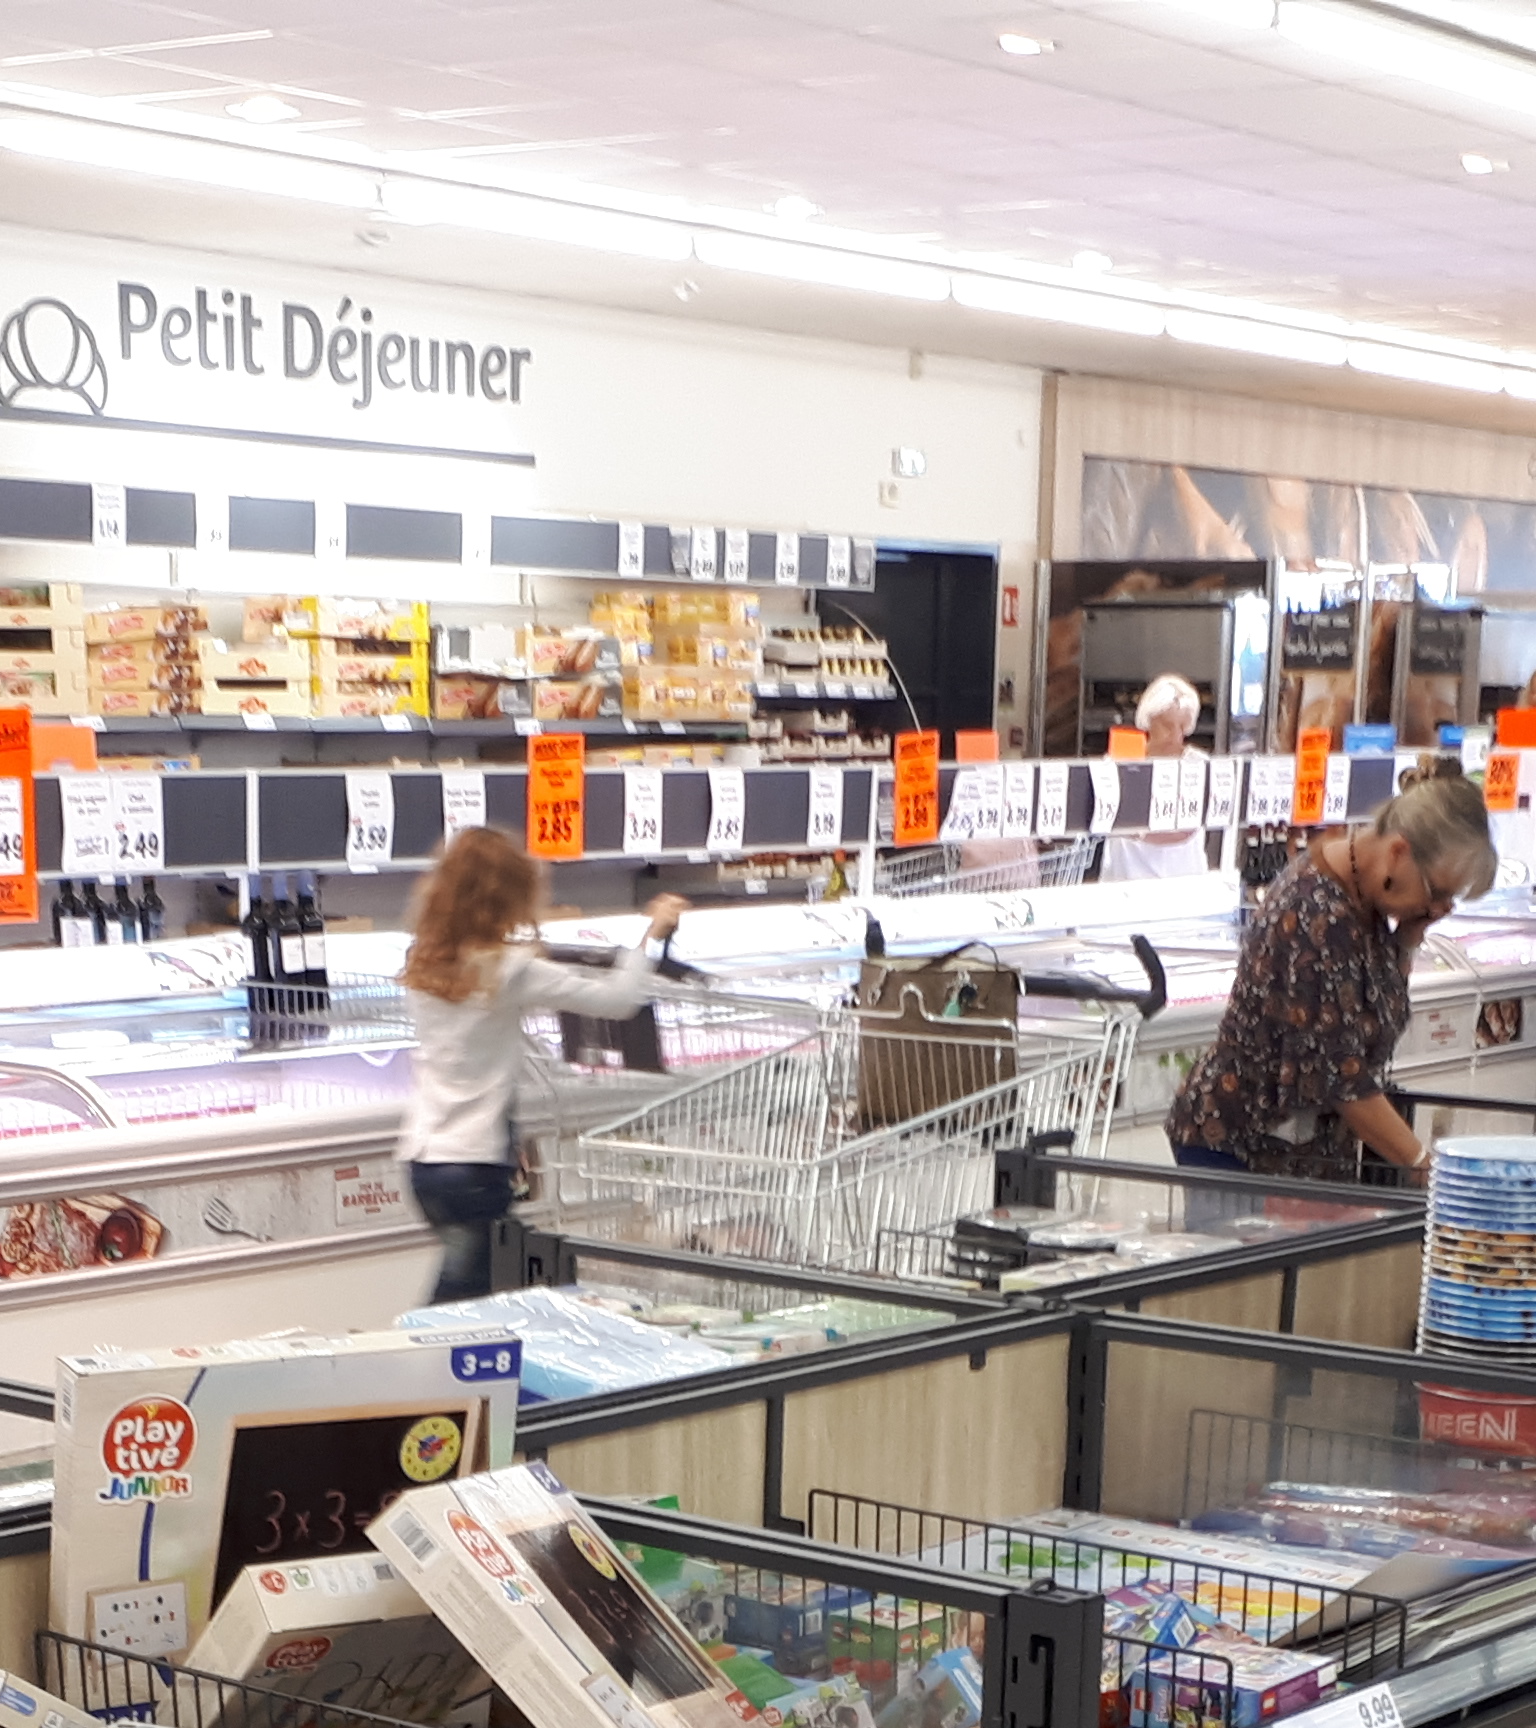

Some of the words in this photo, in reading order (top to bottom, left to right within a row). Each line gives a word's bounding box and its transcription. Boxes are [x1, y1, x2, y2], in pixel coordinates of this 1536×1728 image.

[117, 280, 264, 376] Petit
[282, 297, 531, 409] Déjeuner
[114, 1442, 180, 1471] tive
[1357, 1692, 1397, 1728] 9.99
